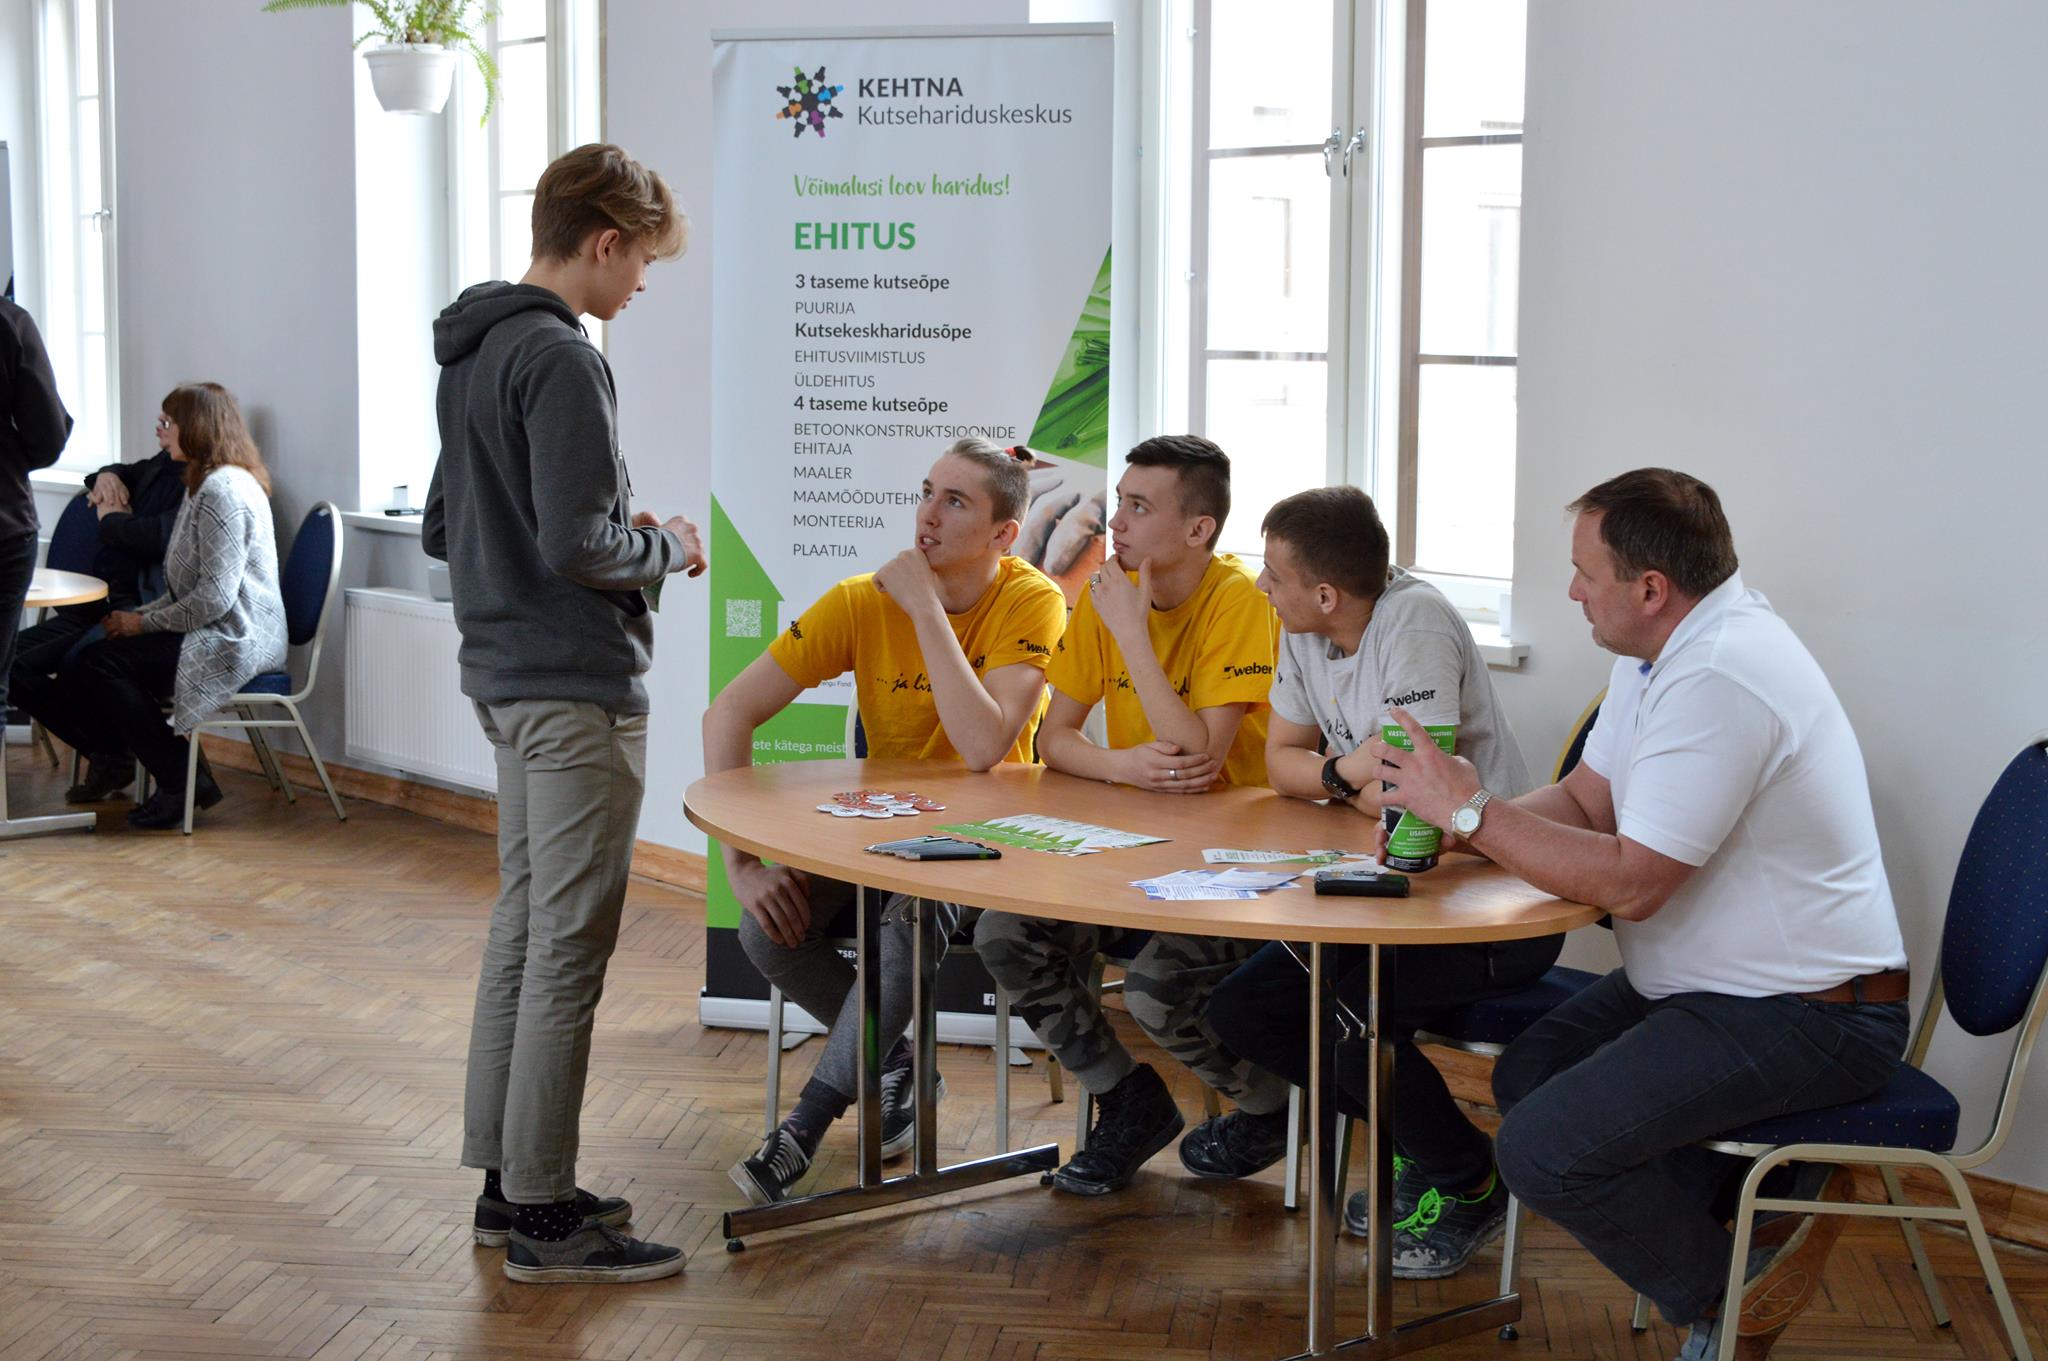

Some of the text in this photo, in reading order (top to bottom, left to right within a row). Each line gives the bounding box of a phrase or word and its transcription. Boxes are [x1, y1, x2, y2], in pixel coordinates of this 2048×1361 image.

[858, 76, 964, 99] KEHTNA
[858, 103, 1073, 126] Kutsehariduskeskus
[793, 173, 1010, 197] Võimalusi loov haridus!
[795, 221, 916, 251] EHITUS
[795, 273, 950, 293] 3 taseme kutseõpe
[795, 301, 856, 315] PUURIJA
[795, 323, 972, 342] Kutsekeskharidusõpe
[795, 350, 926, 365] EHITUSVIIMISTLUS
[795, 372, 875, 388] ÜLDEHITUS
[794, 396, 949, 415] 4 taseme kutseõpe
[795, 423, 1016, 439] BETOONKONSTRUKTSIOONIDE
[794, 441, 853, 456] EHITAJA
[794, 466, 852, 480] MAALER
[794, 514, 885, 529] MONTEERIJA
[793, 543, 858, 558] PLAATIJA
[1233, 662, 1272, 677] weber
[1393, 689, 1436, 707] weber
[774, 739, 813, 754] kätega
